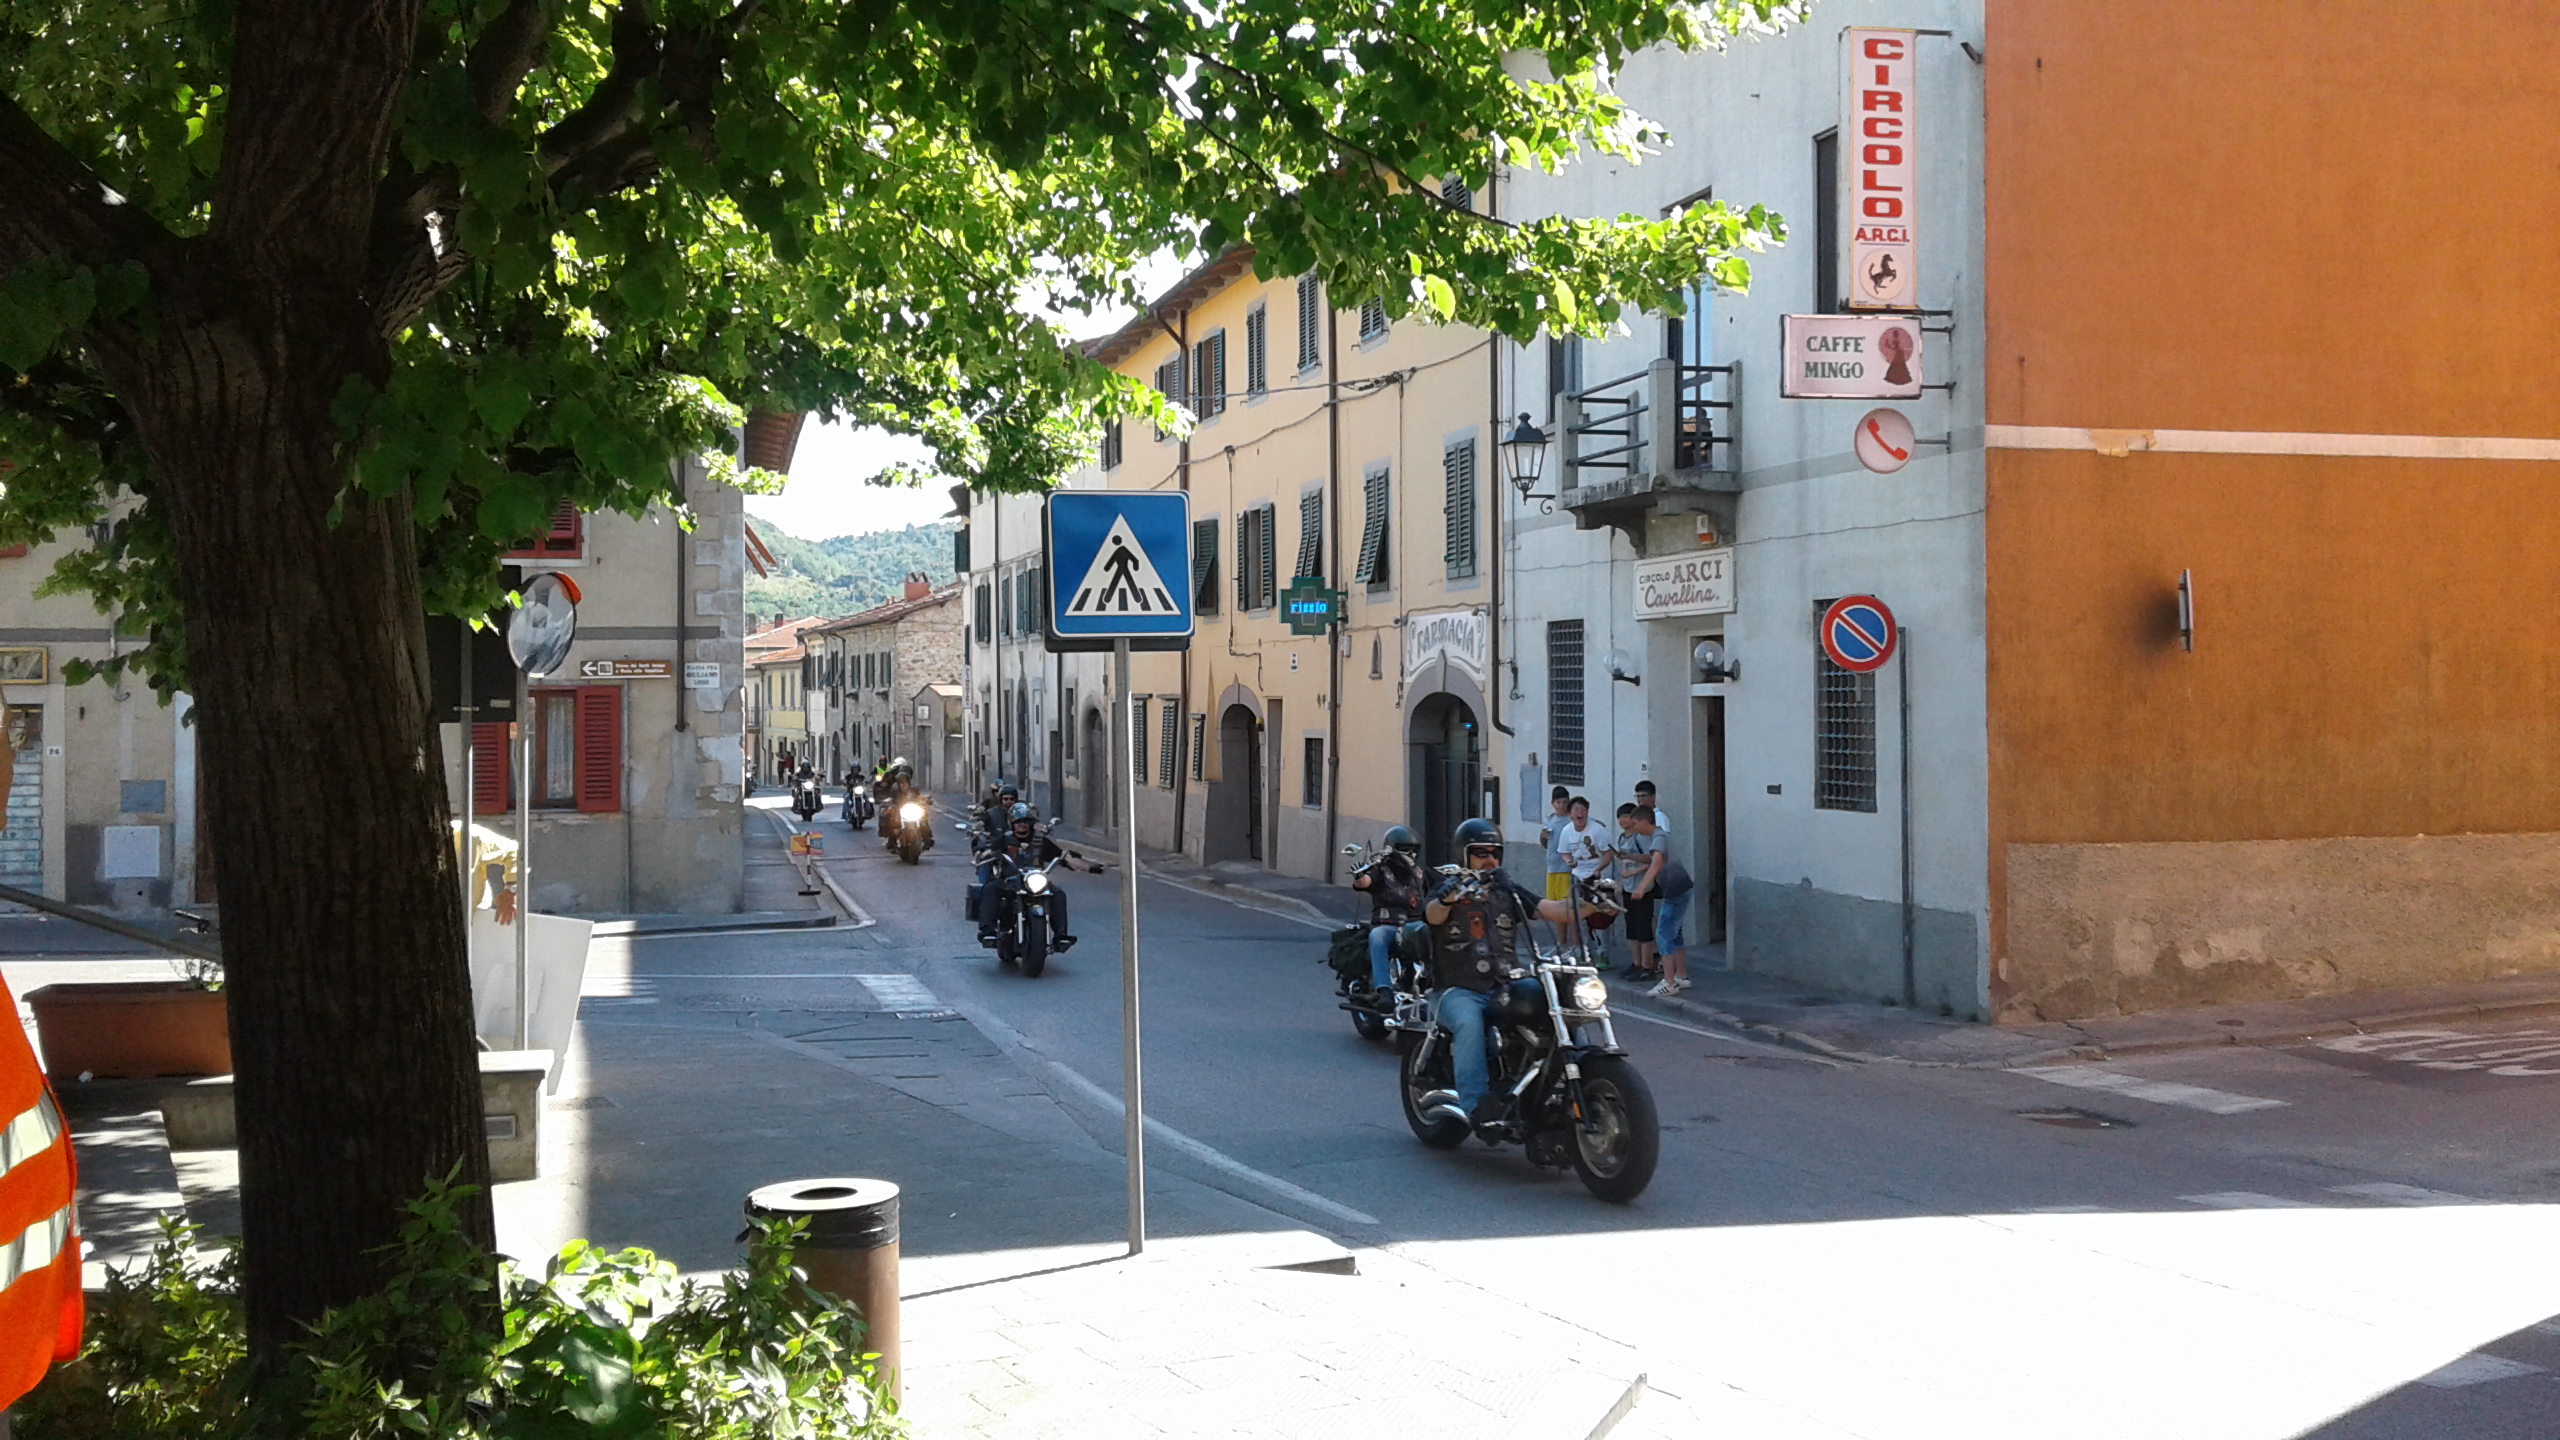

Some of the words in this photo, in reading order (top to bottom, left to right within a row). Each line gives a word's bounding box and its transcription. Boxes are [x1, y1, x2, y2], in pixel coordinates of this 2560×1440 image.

[1862, 38, 1904, 219] CIRCOLO
[1855, 227, 1910, 243] A.R.C.I.
[1804, 361, 1864, 379] MINGO
[1639, 571, 1670, 584] CIRCOLO
[1671, 559, 1722, 584] ARCI
[1416, 617, 1474, 659] FARMACIA
